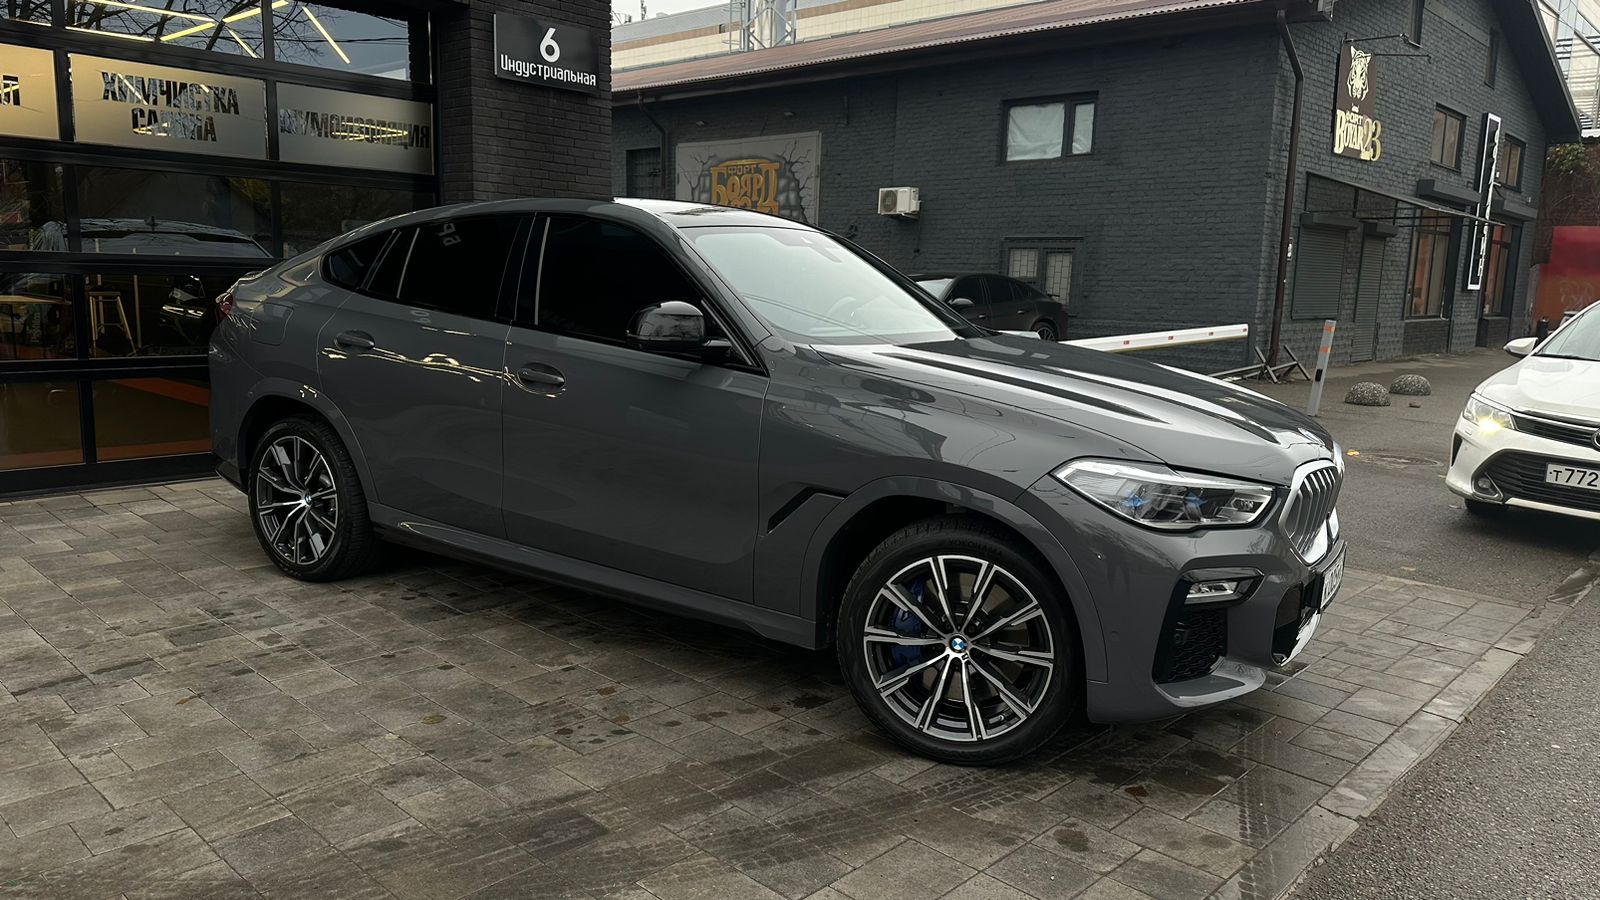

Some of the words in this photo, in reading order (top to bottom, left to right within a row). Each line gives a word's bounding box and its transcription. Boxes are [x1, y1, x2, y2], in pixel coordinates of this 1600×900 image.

[539, 27, 560, 63] 6
[500, 53, 597, 87] Индустриальная
[101, 71, 240, 115] ХИМЧИСТКА
[727, 164, 757, 175] ФОРТ
